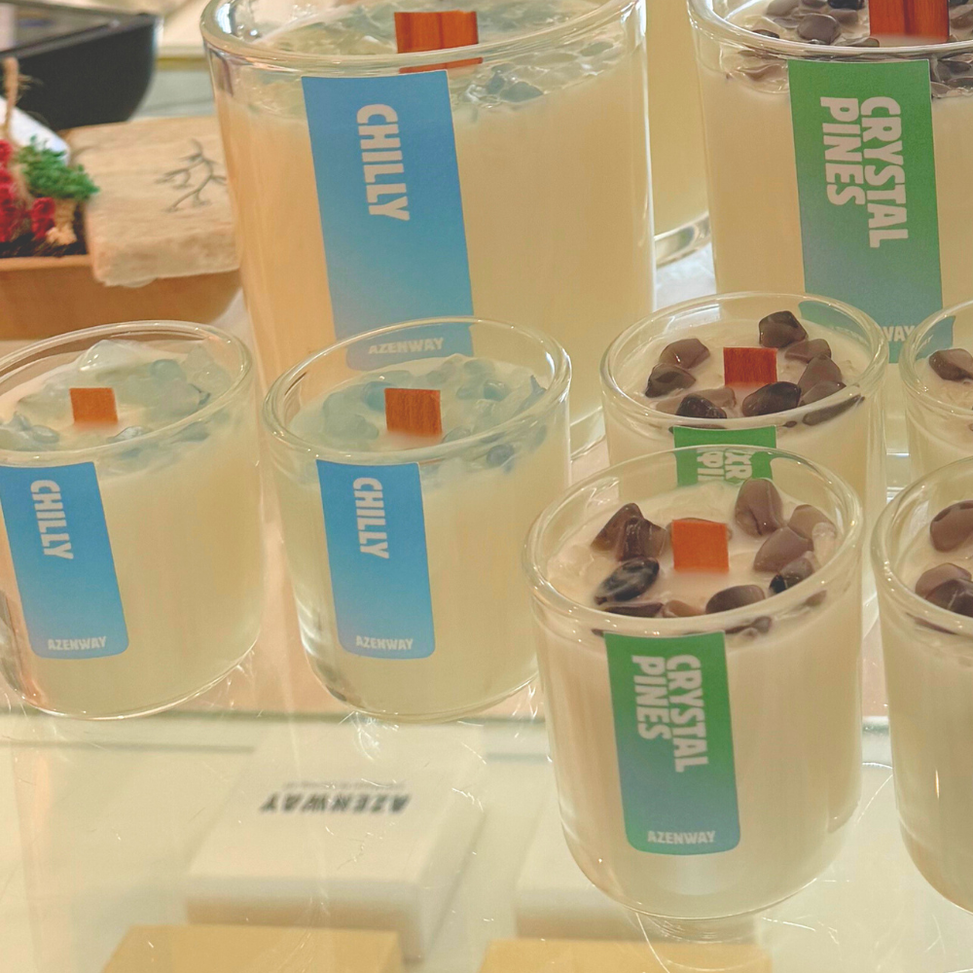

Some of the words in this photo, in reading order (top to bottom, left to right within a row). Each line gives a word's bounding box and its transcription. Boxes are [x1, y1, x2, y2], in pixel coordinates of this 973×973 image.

[356, 102, 410, 221] CHILLY
[820, 96, 866, 207] PINES
[860, 95, 910, 249] CRYSTAL
[368, 337, 445, 355] AZENWAY
[30, 479, 74, 560] CHILLY
[352, 476, 390, 560] CHILLY
[47, 635, 108, 652] AZENWAY
[355, 635, 414, 651] AZENWAY
[631, 654, 671, 741] PINES
[665, 654, 710, 773] CRYSTAL
[647, 829, 717, 845] AZENWAY
